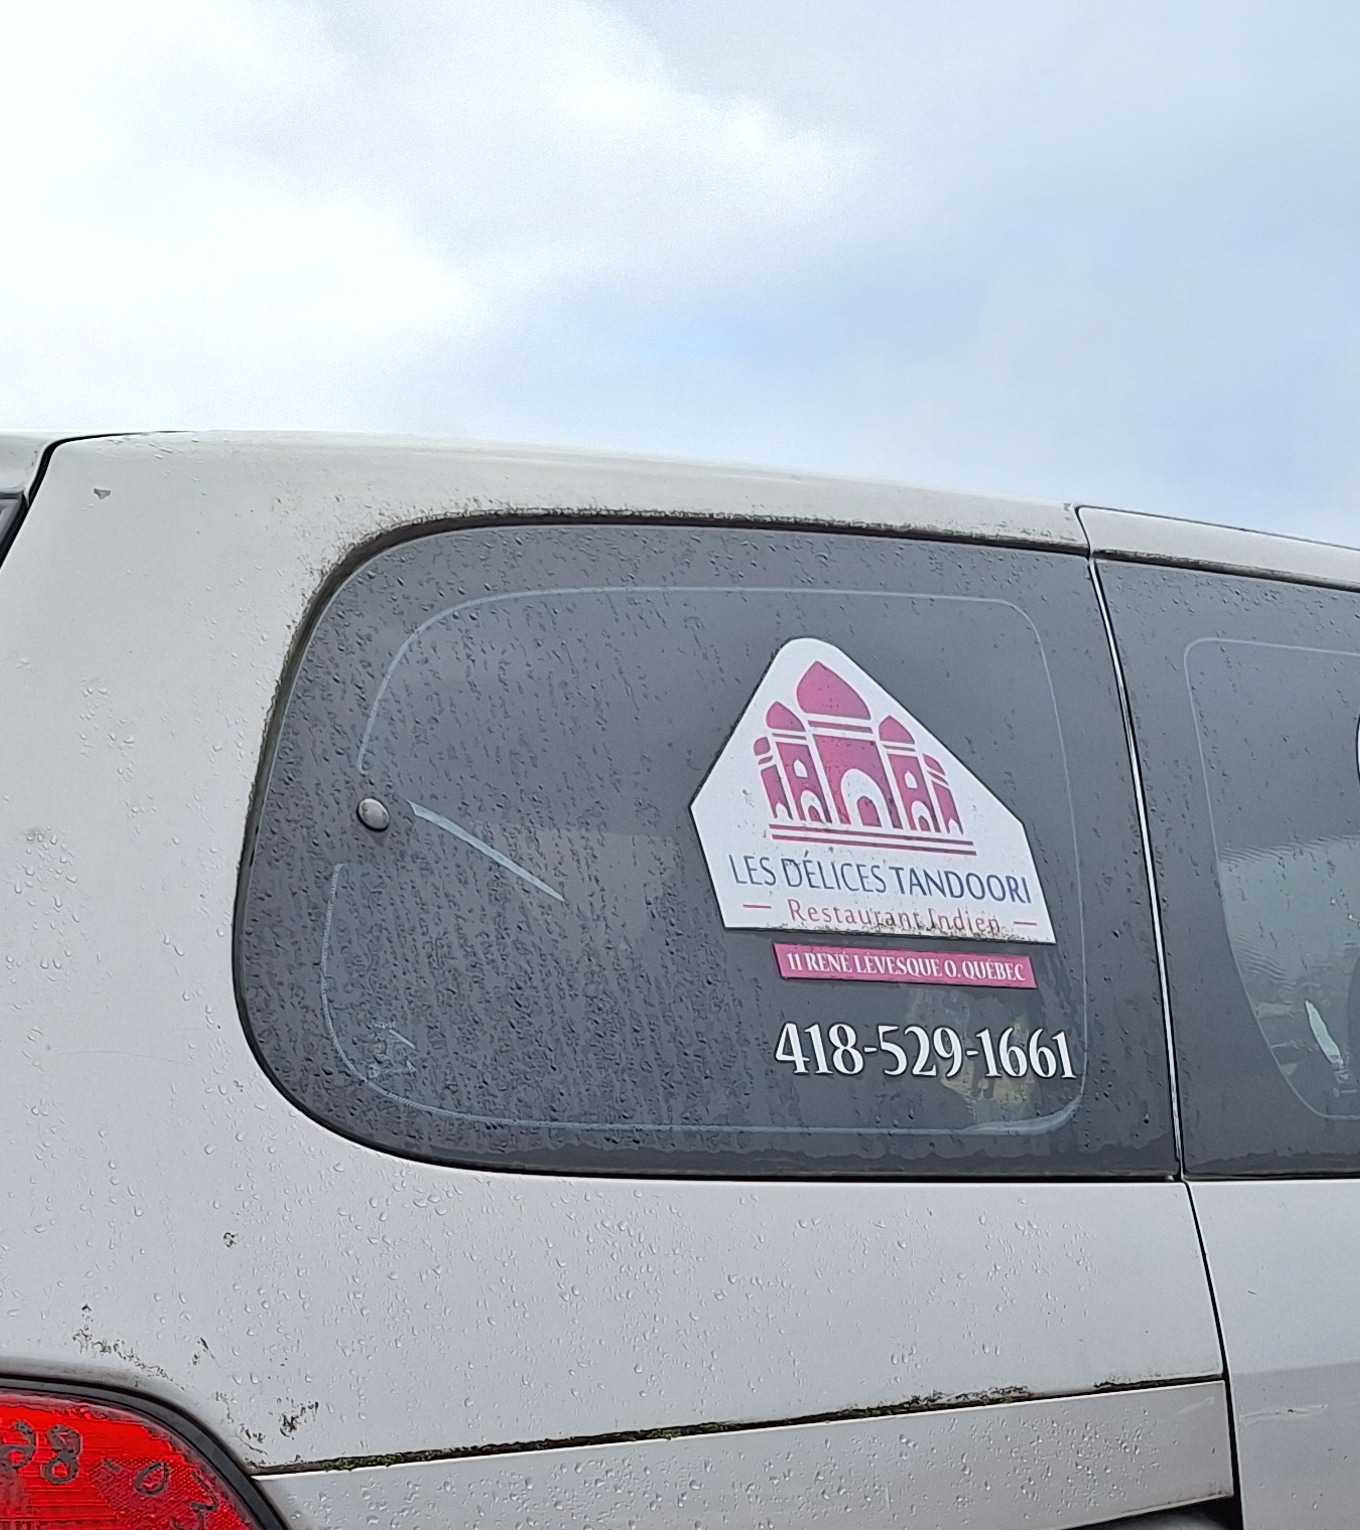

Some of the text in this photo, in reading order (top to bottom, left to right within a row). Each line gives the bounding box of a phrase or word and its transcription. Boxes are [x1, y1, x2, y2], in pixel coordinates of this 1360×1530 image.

[728, 850, 1033, 904] LES DÉLICES TANDOORI
[787, 898, 1001, 937] Restaurant Indien
[806, 951, 850, 974] RENÉ
[854, 950, 944, 978] LÉVESQUE
[774, 1021, 1078, 1081] 418-529-1661
